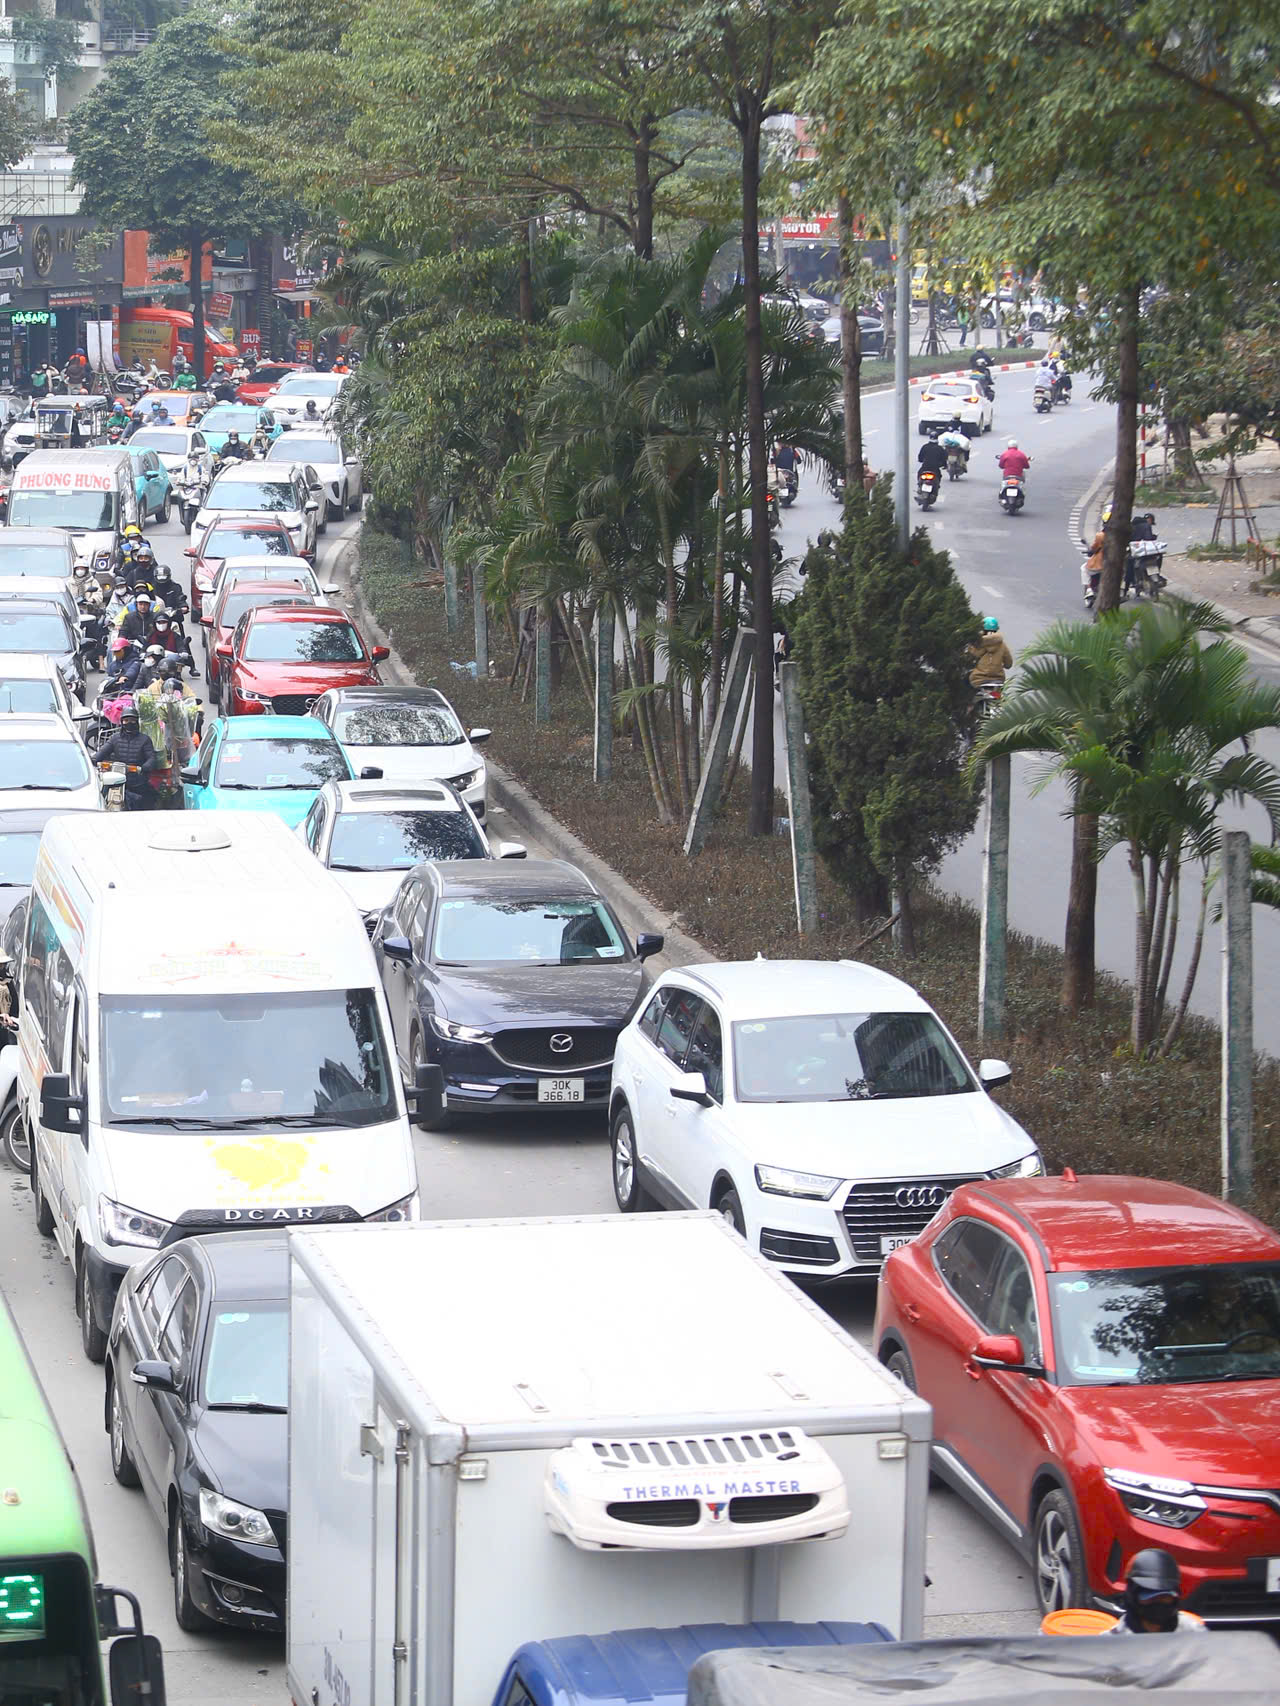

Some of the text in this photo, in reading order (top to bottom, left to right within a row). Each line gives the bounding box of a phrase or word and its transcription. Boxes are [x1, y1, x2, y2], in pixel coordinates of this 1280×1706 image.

[781, 222, 821, 234] MOTOR
[20, 471, 111, 491] PHƯƠNG HƯNG
[551, 1080, 571, 1090] 30K
[543, 1091, 580, 1102] 366.18
[224, 1207, 314, 1221] DCAR
[623, 1480, 801, 1499] THERMAL MASTER
